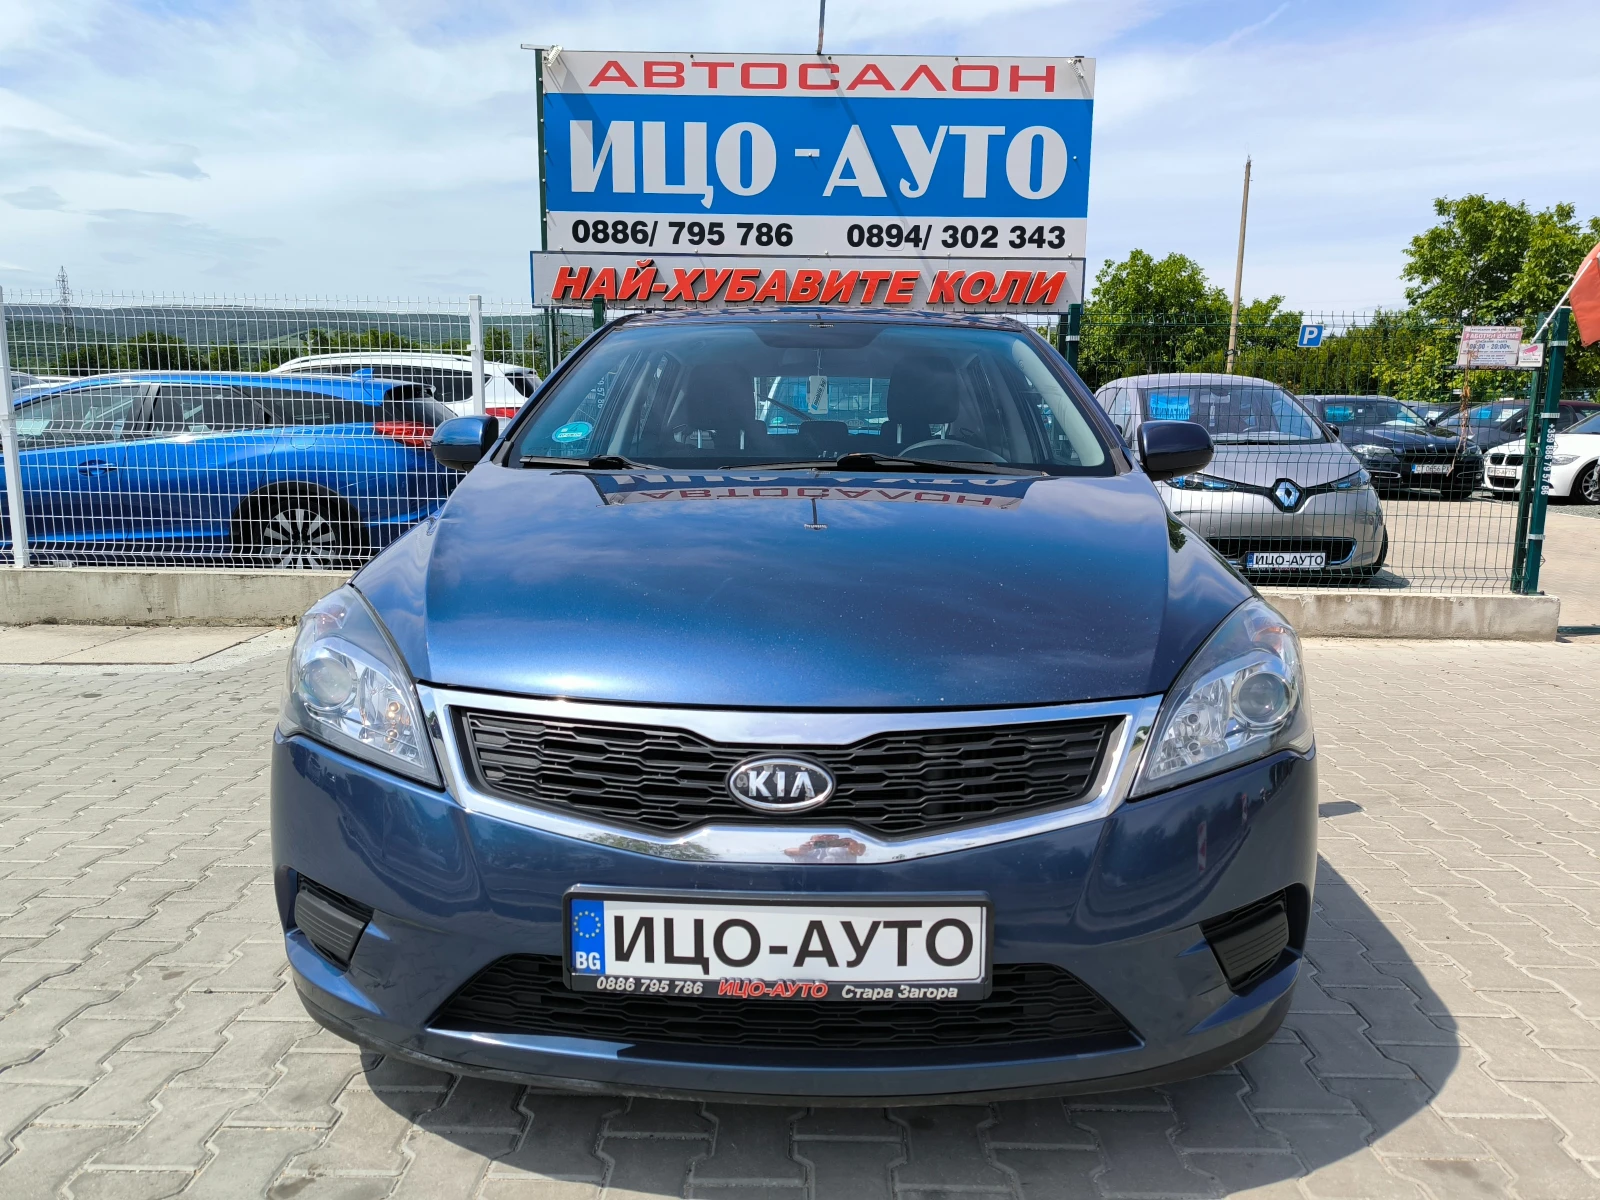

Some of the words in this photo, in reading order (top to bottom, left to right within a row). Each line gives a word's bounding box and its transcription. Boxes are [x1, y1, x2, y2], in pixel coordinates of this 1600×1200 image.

[588, 60, 1056, 92] АВТОСАЛОН
[571, 219, 659, 247] 0886/
[668, 221, 725, 247] 795
[736, 221, 794, 247] 786
[846, 222, 932, 250] 0894/
[941, 224, 998, 249] 302
[1008, 224, 1066, 250] 343
[551, 259, 920, 304] НАЙ-ХУБАВИТЕ
[925, 269, 1068, 305] КОЛИ
[1303, 327, 1318, 345] P
[1546, 423, 1556, 443] +359
[1544, 445, 1554, 460] 886
[1543, 461, 1552, 471] 79
[1542, 475, 1551, 484] 57
[1541, 485, 1550, 495] 86
[1255, 555, 1324, 566] ИЦО-АУТО
[747, 770, 816, 798] KIA
[613, 914, 974, 975] ИЦО-АУТО
[575, 951, 600, 970] BG
[597, 977, 636, 992] 0886
[639, 978, 671, 993] 795
[673, 980, 703, 995] 786
[717, 978, 829, 999] ИЦО-АУТО
[841, 984, 894, 999] Стара
[897, 984, 959, 1001] Загора
